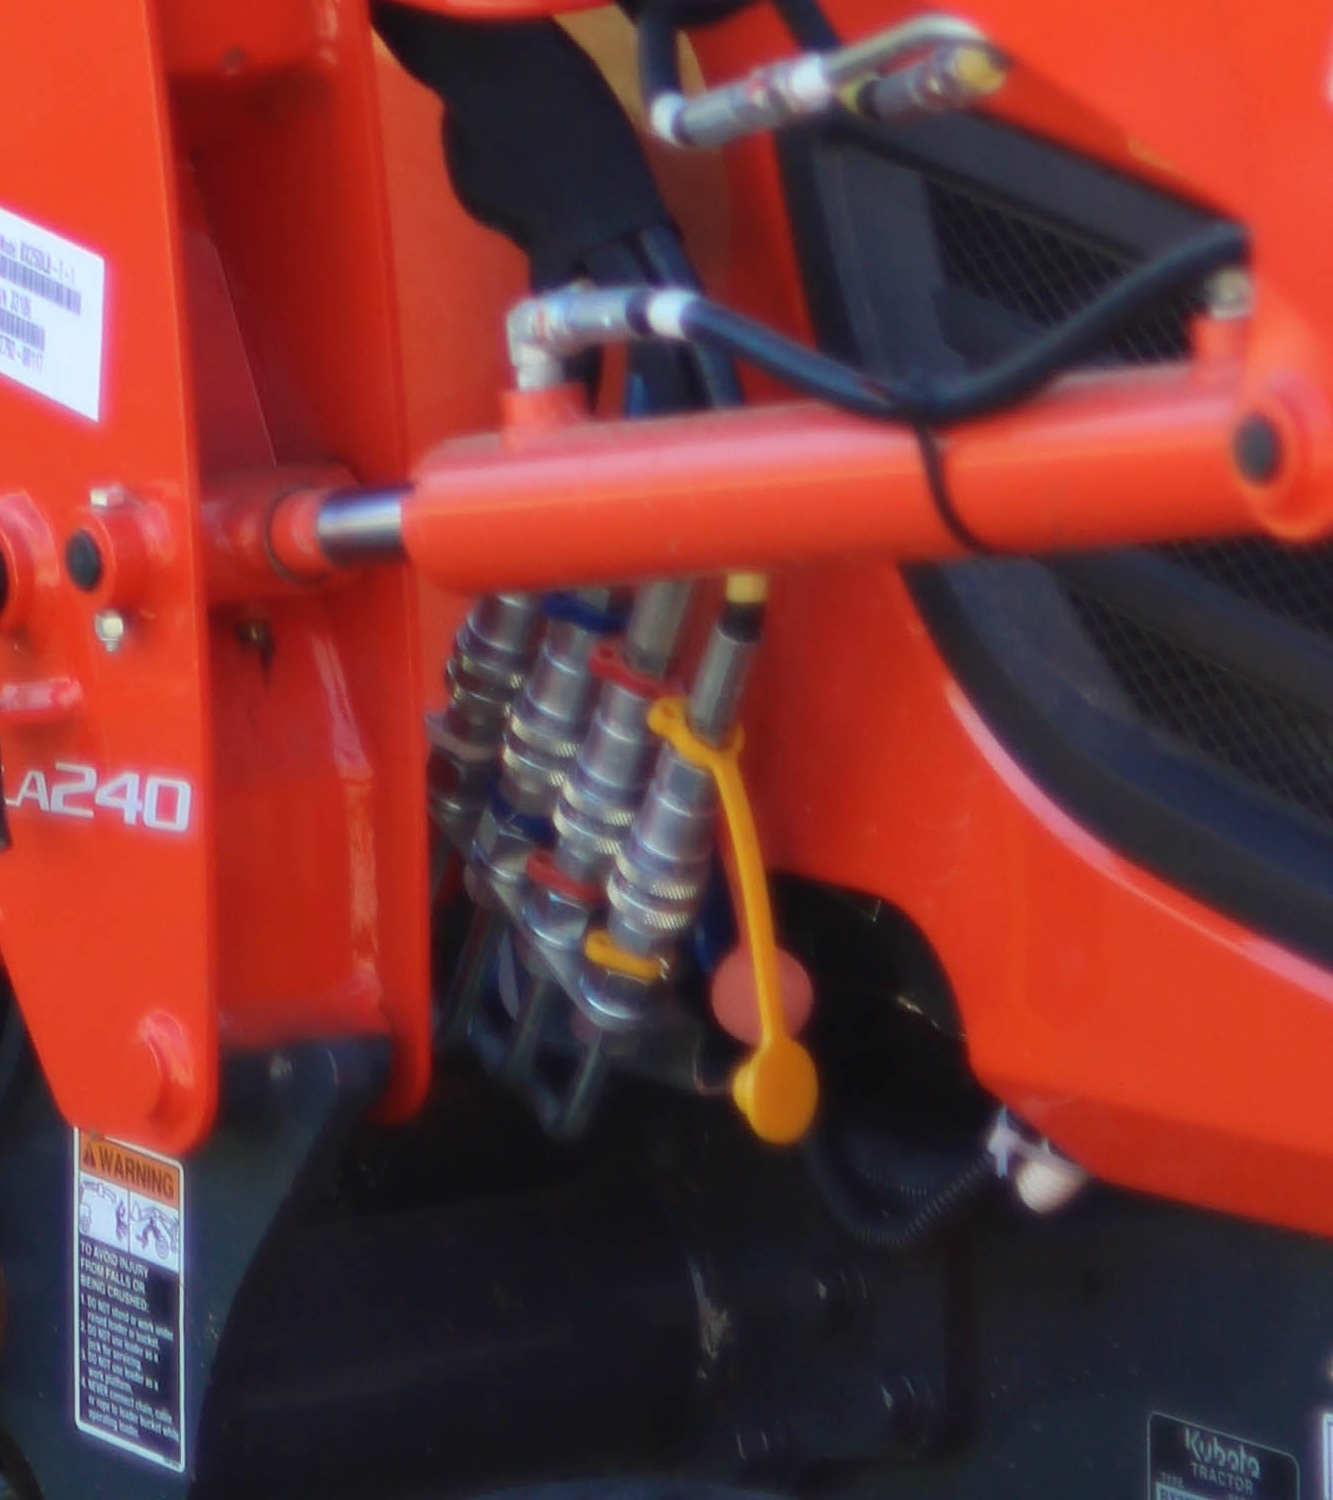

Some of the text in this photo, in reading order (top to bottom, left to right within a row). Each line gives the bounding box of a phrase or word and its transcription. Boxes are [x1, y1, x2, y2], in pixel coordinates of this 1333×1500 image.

[99, 1144, 175, 1199] WARNING
[81, 1239, 149, 1279] TO AVOID INJURY
[81, 1257, 145, 1294] FROM FALLS OR
[81, 1273, 105, 1295] BEING
[1185, 1427, 1261, 1480] Kubota
[1190, 1461, 1254, 1495] TRACTOR
